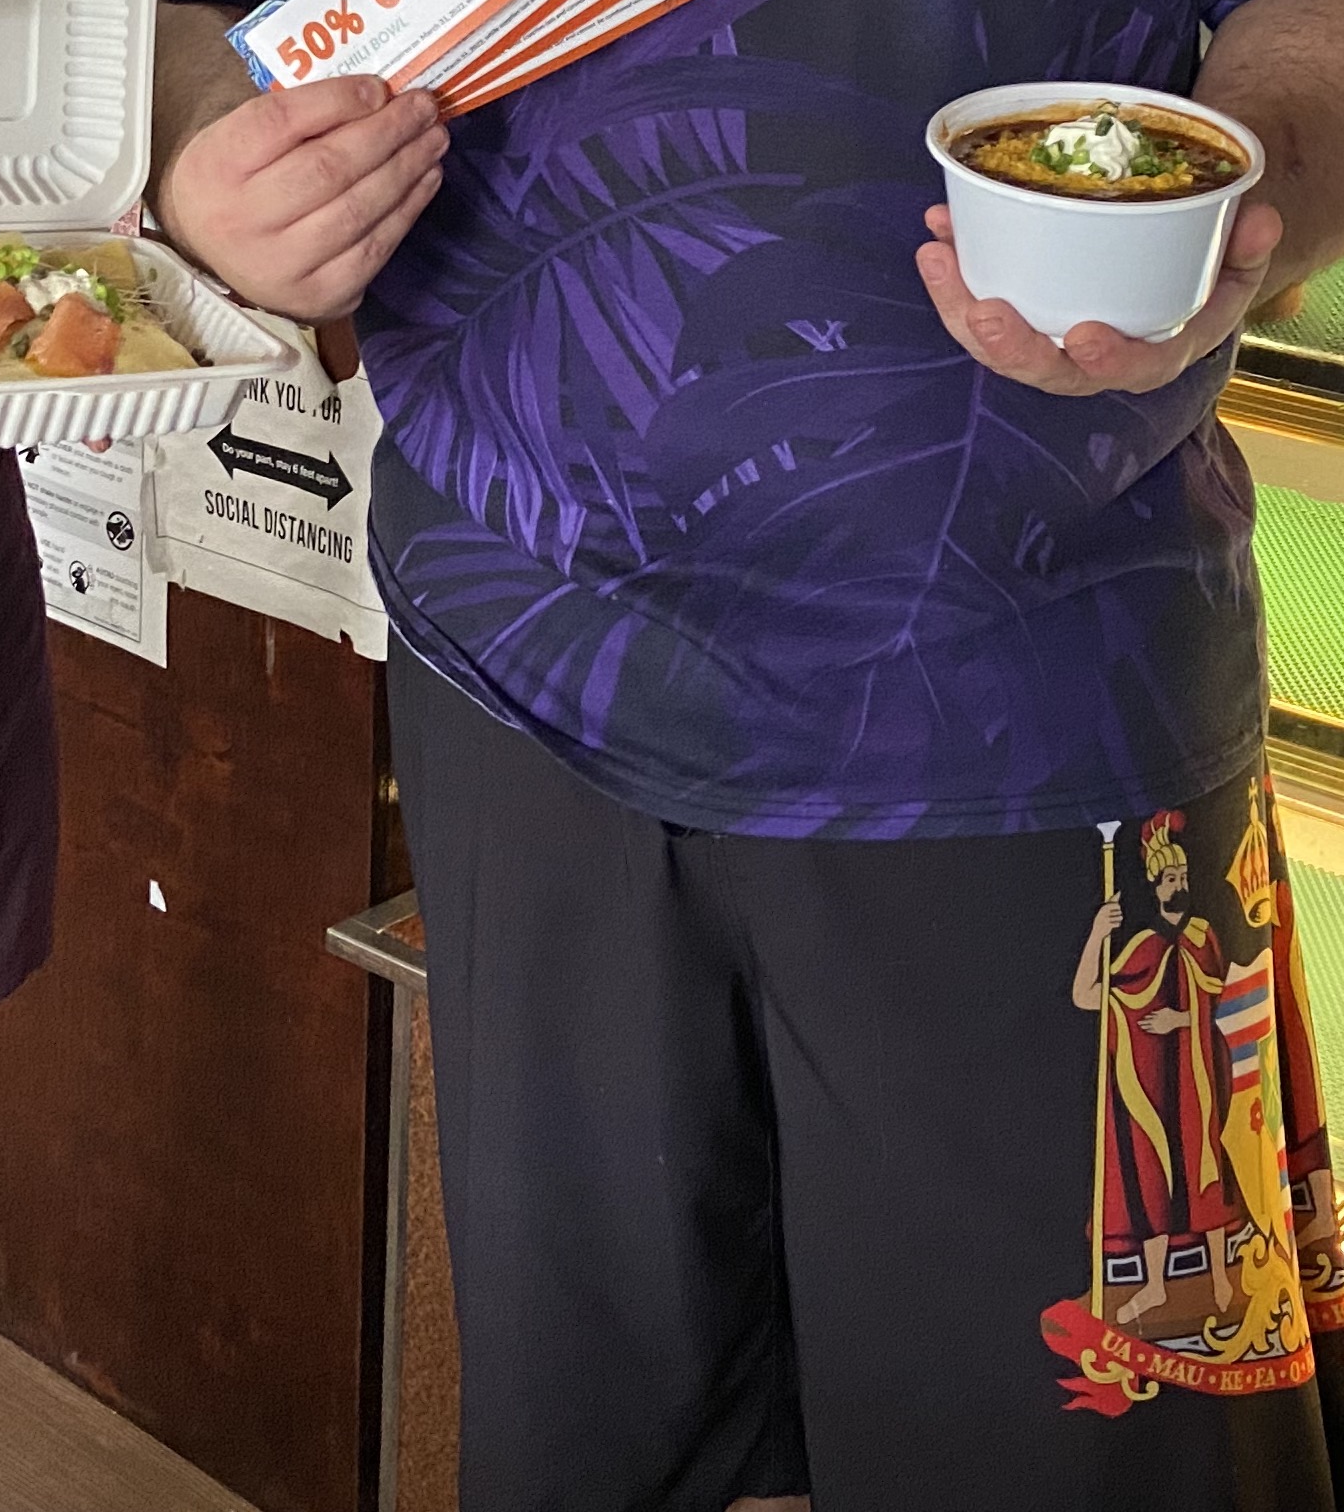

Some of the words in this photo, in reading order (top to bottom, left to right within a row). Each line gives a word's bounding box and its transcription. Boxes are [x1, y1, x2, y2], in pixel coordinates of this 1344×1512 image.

[336, 44, 371, 77] CHILI
[372, 16, 411, 51] BOWL
[419, 25, 439, 41] March
[222, 442, 234, 454] Do
[234, 448, 254, 460] your
[275, 460, 292, 473] stay
[205, 489, 260, 530] SOCIAL
[264, 507, 353, 564] DISTANCING
[1102, 1330, 1132, 1363] UA
[1147, 1354, 1206, 1385] MAU
